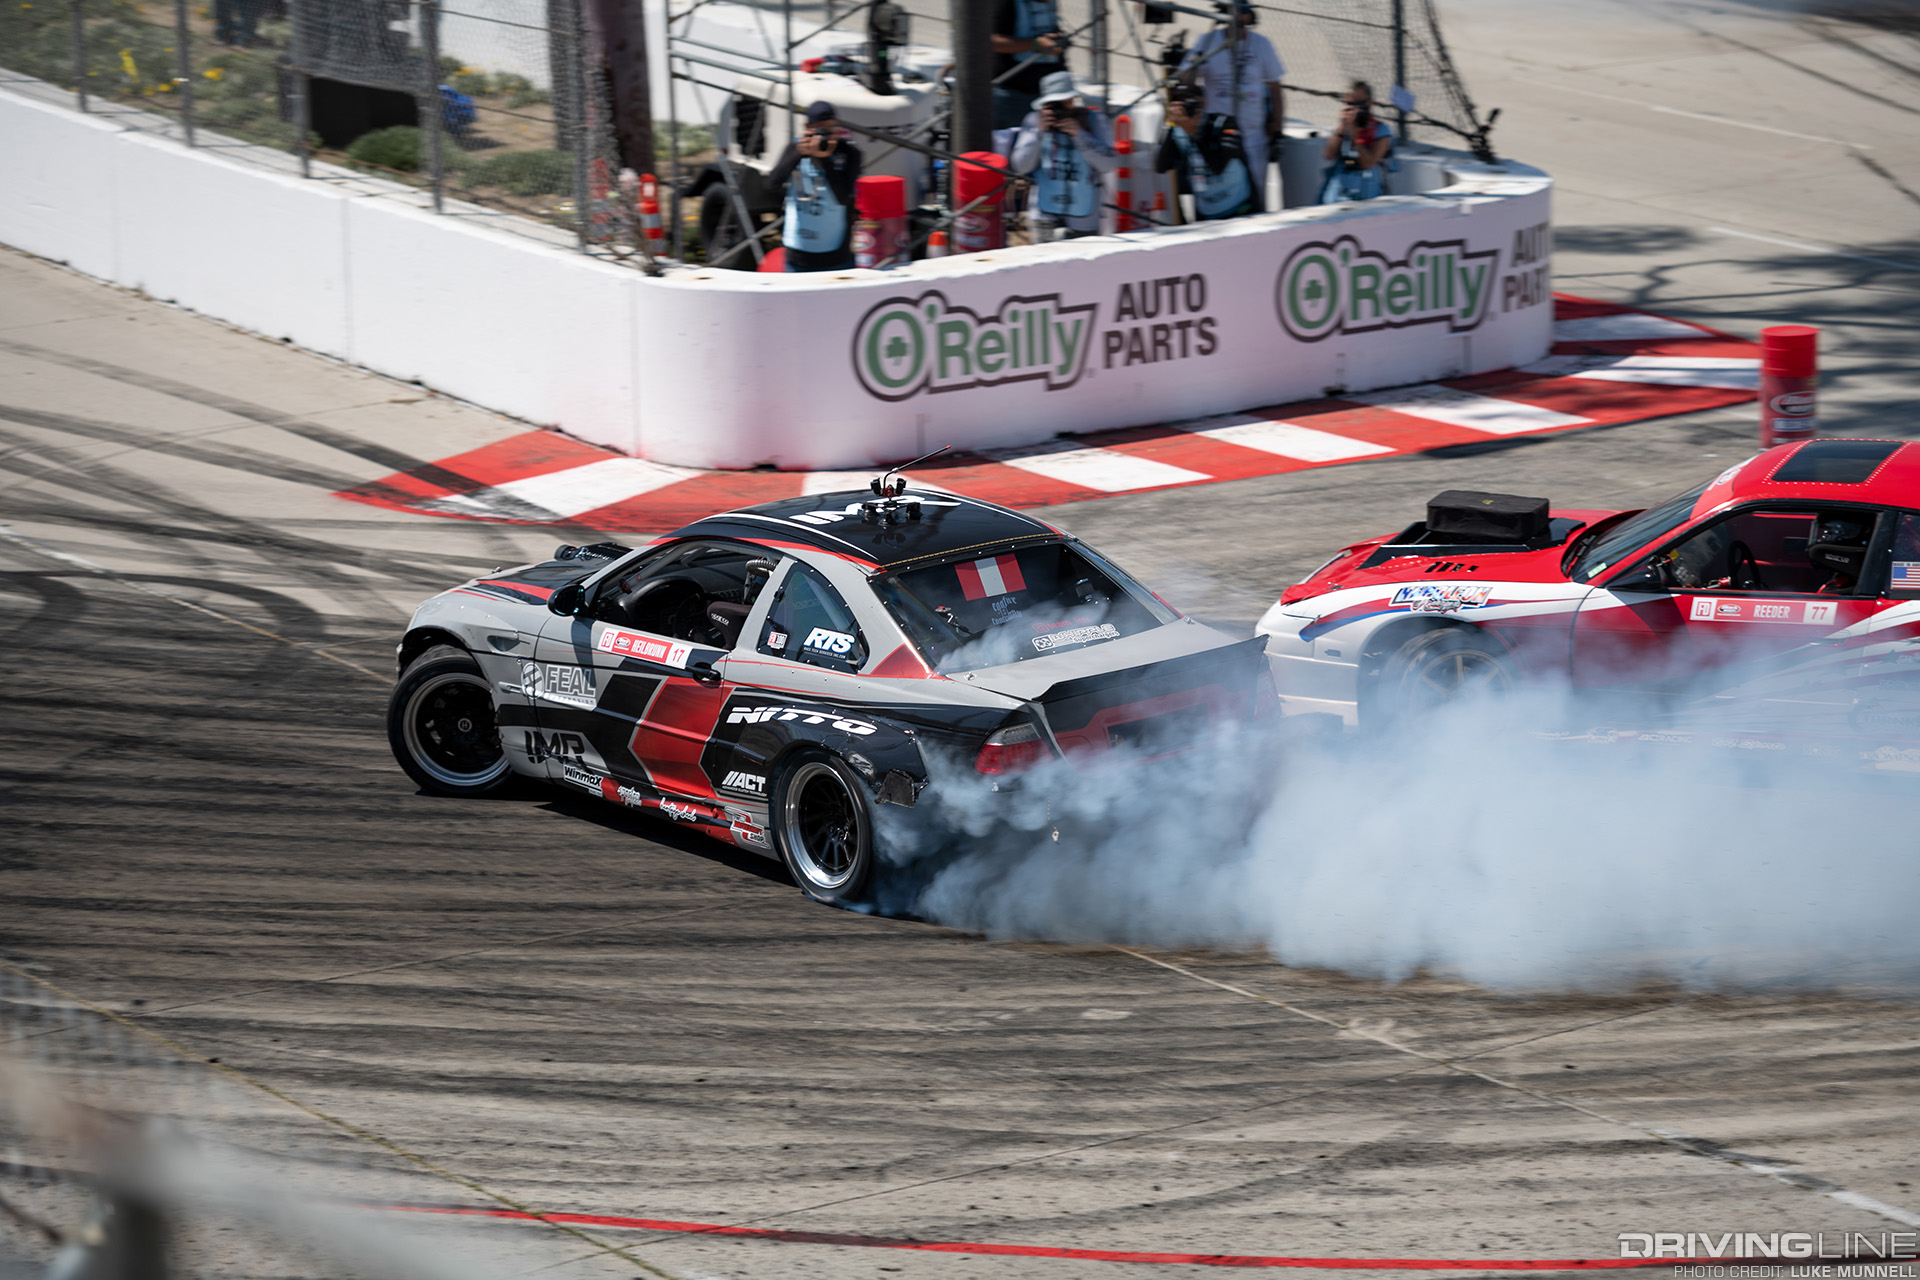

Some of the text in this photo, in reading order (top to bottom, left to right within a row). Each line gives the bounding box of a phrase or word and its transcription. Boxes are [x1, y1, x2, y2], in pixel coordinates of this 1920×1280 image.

[1114, 273, 1208, 322] AUTO
[1287, 249, 1490, 331] O'Reilly
[865, 303, 1085, 388] O'Reilly
[1104, 317, 1218, 369] PARTS
[1392, 586, 1493, 605] NAPOLEON
[1753, 604, 1791, 619] REEDER
[1811, 606, 1829, 620] 77
[631, 639, 668, 659] HEILBRUNN
[672, 648, 685, 663] 17
[803, 627, 855, 653] RTS
[546, 664, 596, 698] FEAL
[726, 706, 878, 736] NITTO
[524, 730, 591, 773] IMR
